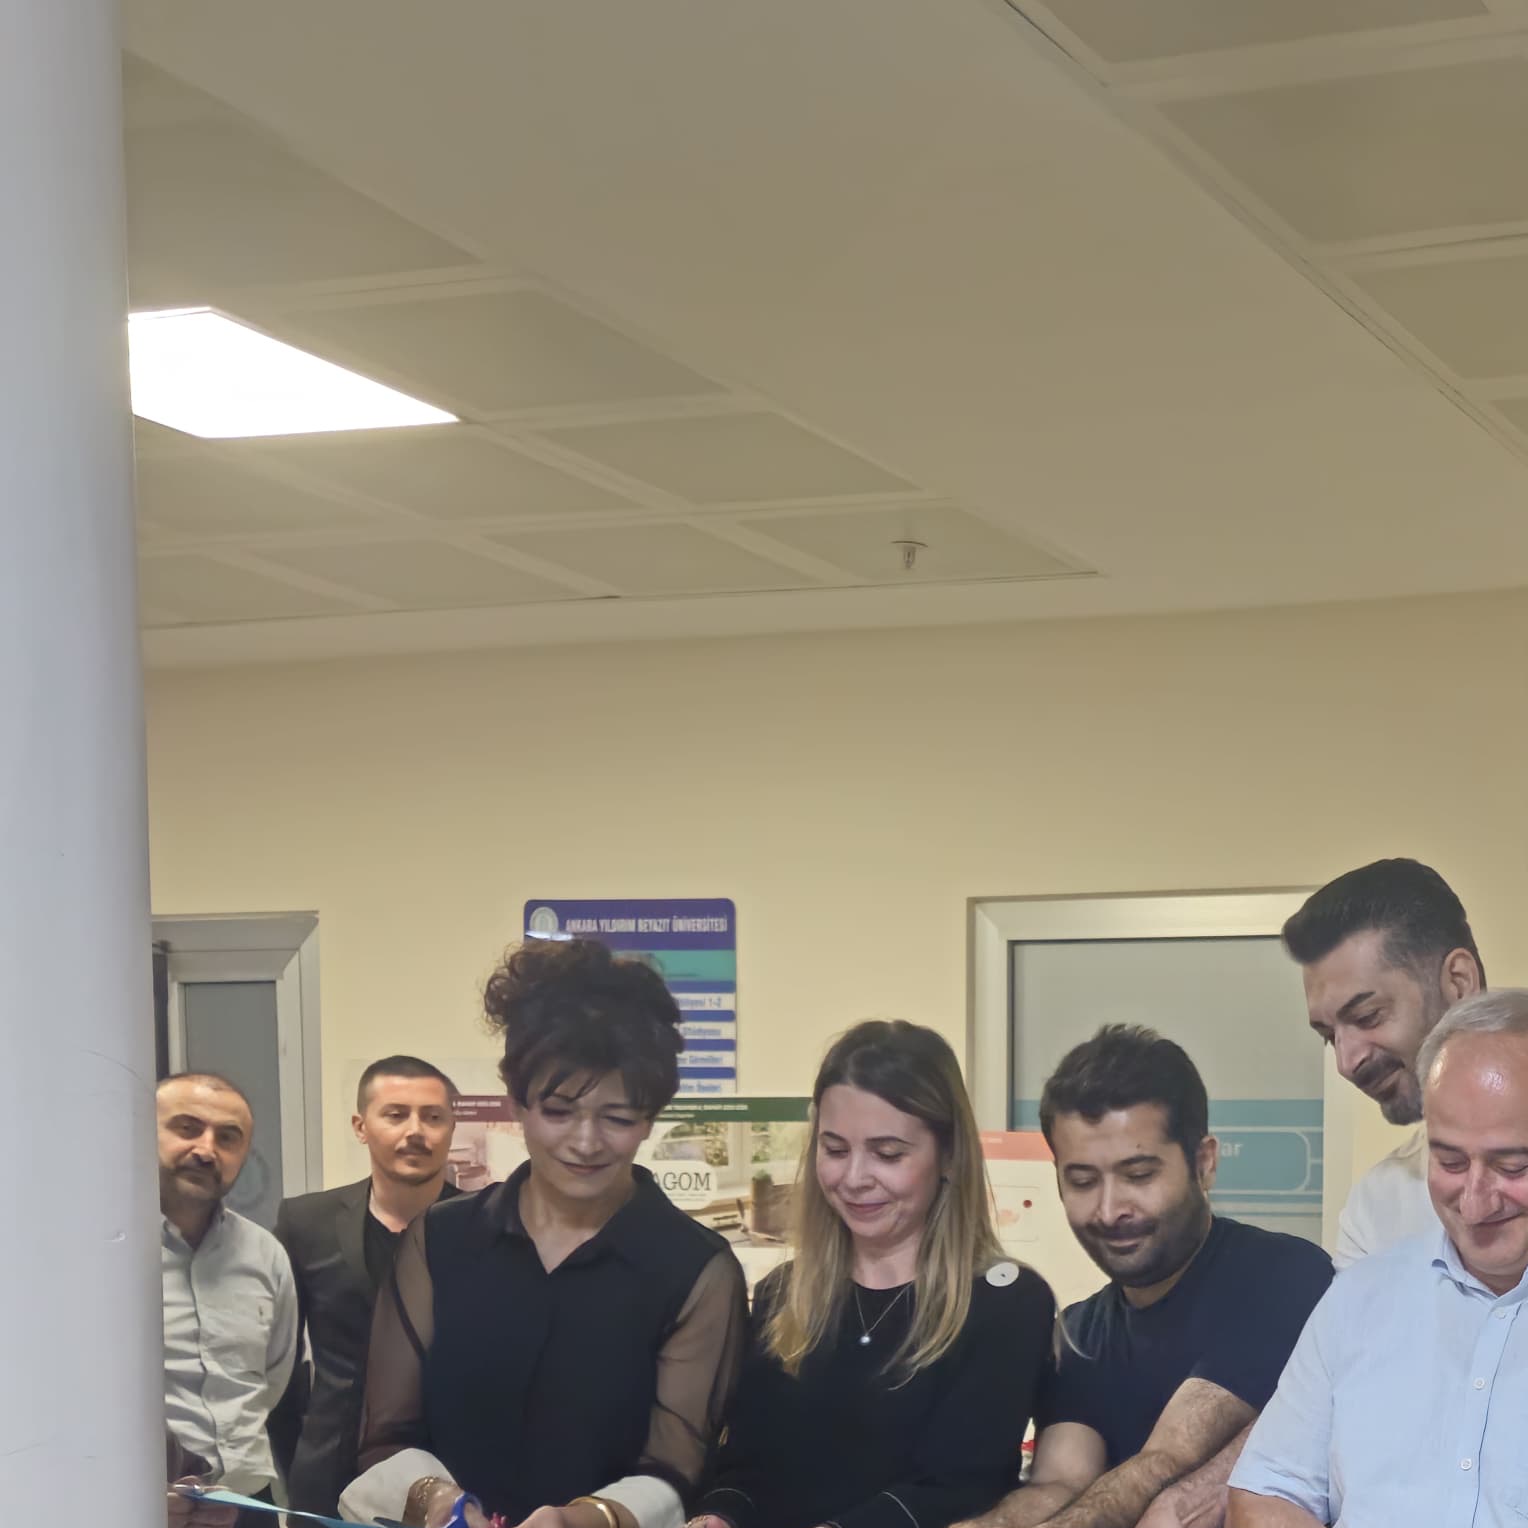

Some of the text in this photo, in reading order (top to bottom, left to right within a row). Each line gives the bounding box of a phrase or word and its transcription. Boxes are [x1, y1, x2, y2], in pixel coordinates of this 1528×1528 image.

[565, 915, 728, 932] ANKARA YILDIRIM BEYAZIT ÜNİVERSİTESİ
